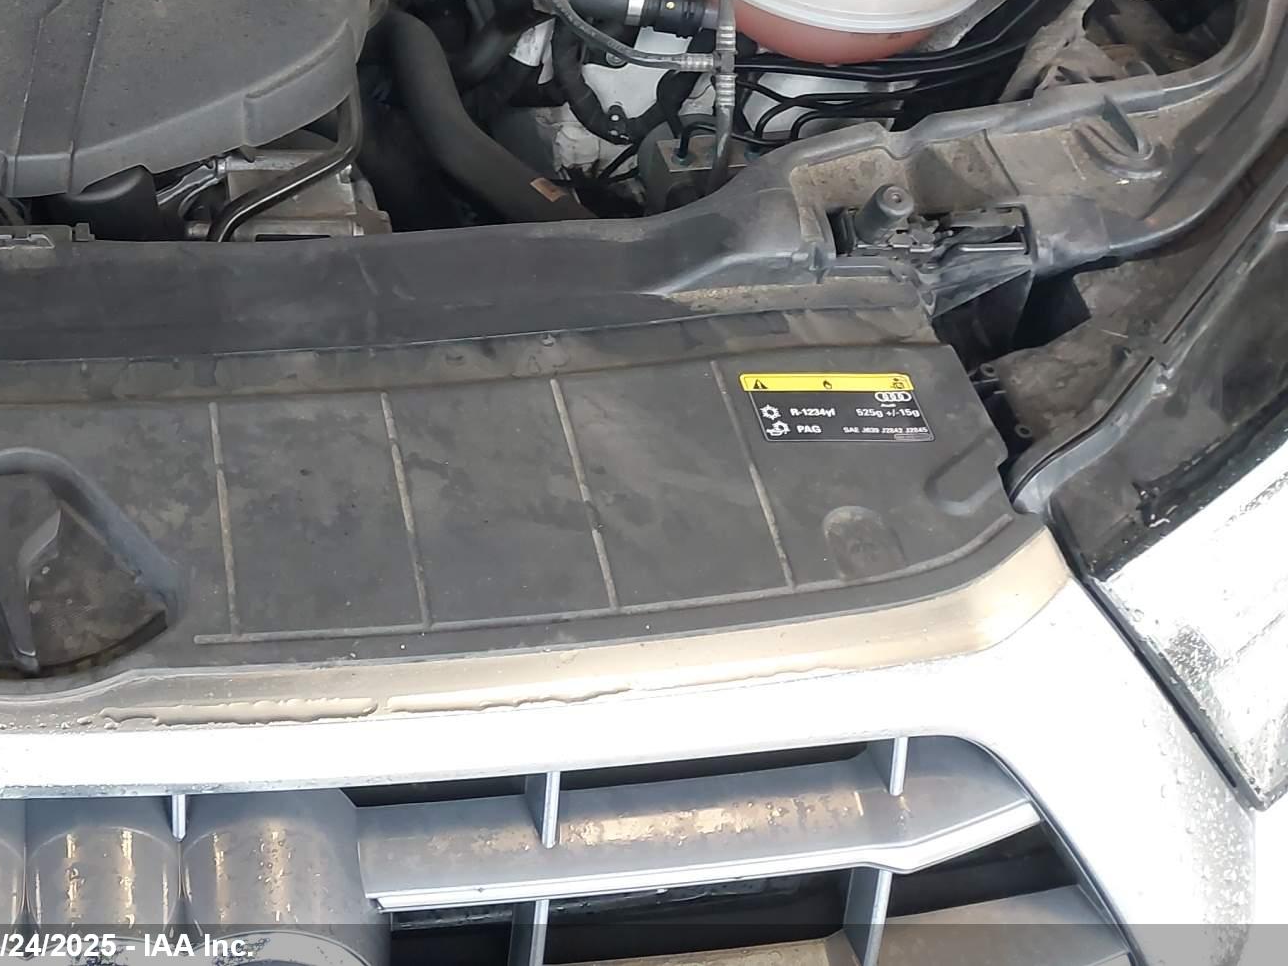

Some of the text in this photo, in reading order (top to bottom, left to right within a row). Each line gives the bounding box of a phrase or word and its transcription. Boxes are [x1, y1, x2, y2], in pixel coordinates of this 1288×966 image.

[790, 408, 836, 417] R-1234yf
[855, 408, 883, 418] 525g
[796, 425, 822, 433] PAG
